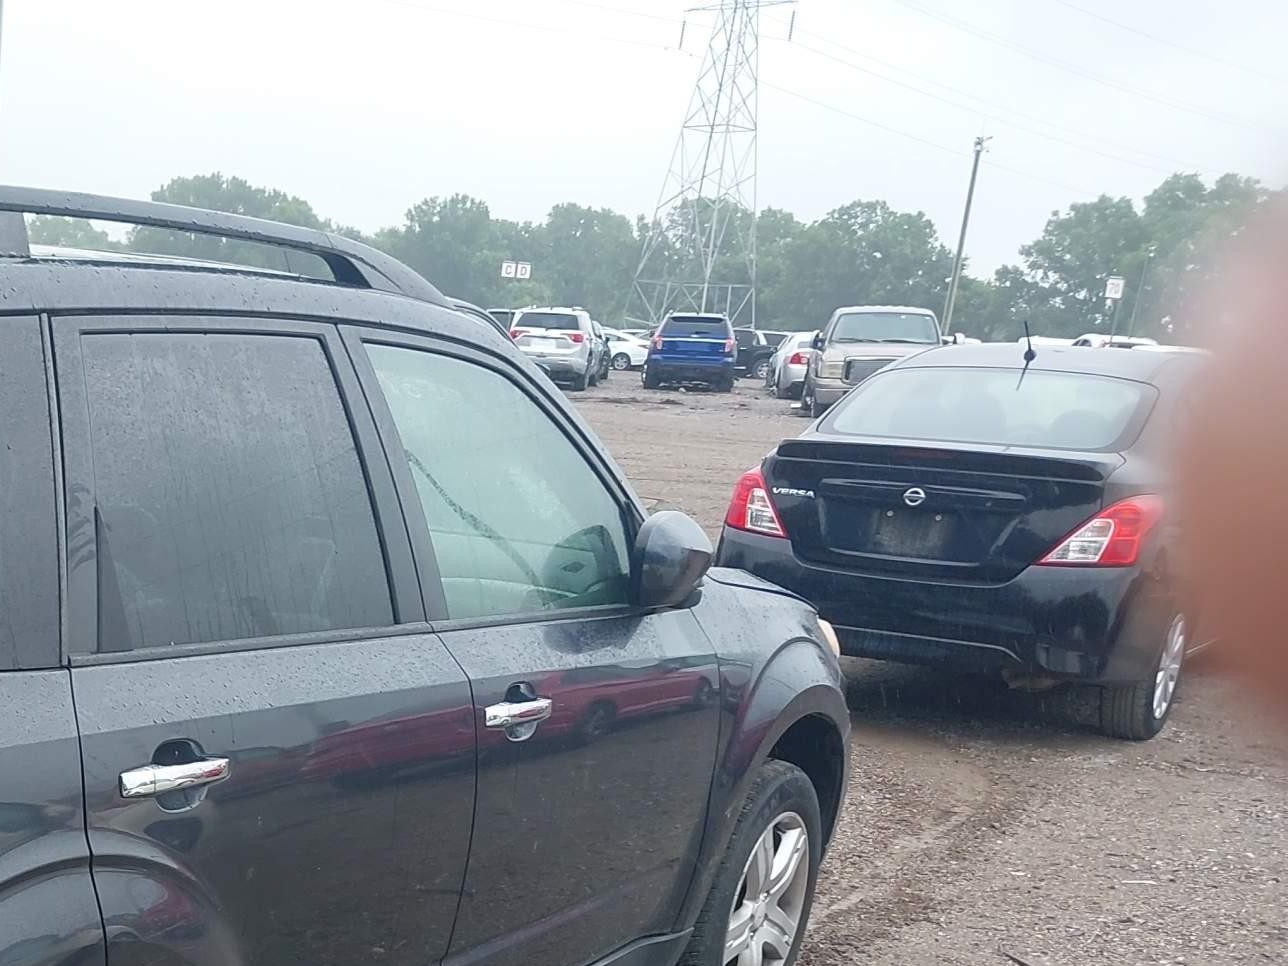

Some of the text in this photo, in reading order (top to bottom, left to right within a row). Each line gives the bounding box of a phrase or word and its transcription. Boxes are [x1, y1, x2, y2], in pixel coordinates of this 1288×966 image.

[504, 264, 513, 275] C
[519, 265, 528, 276] D
[772, 486, 816, 499] VERSA
